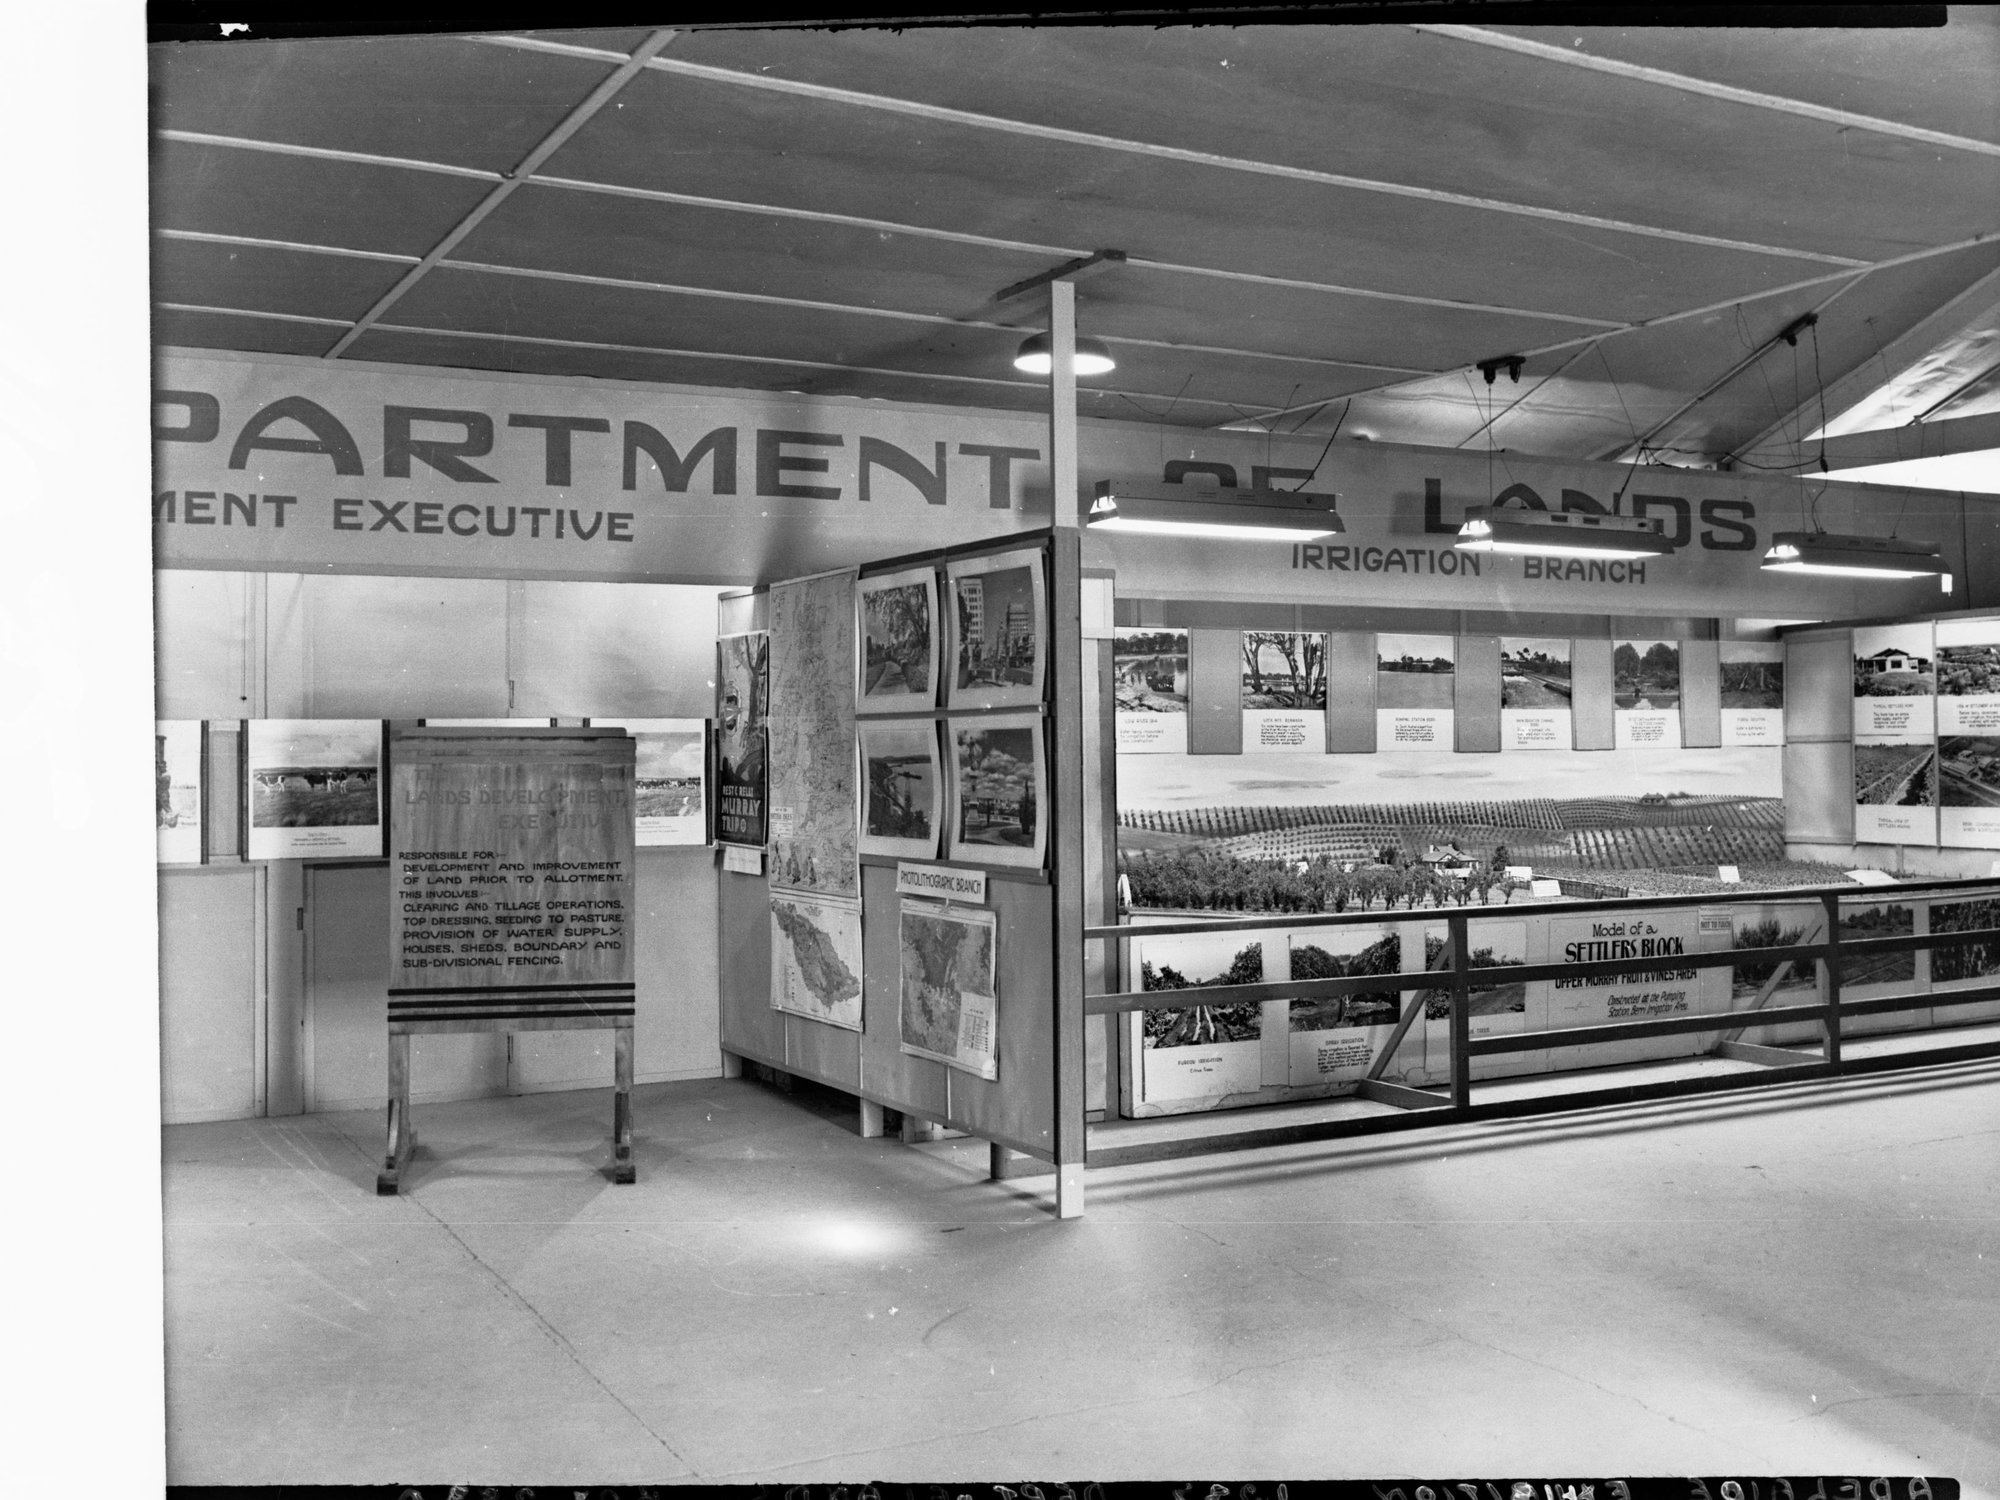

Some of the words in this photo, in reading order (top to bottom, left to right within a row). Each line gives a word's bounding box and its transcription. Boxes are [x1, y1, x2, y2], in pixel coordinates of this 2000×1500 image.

[152, 389, 1041, 509] PARTMENT
[333, 498, 634, 542] EXECUTIVE
[1293, 543, 1480, 578] IRRIGATION
[1524, 557, 1646, 584] BRANCH
[722, 784, 735, 797] REST
[721, 797, 761, 817] MURRAY
[499, 813, 608, 830] EXECUTIV
[721, 815, 740, 833] TRIP
[399, 851, 468, 860] RESPONSIBLE
[403, 863, 490, 873] DEVELOPMENT
[498, 862, 525, 871] AND
[533, 861, 621, 870] IMPROVEMENT
[403, 876, 419, 885] OF
[427, 875, 463, 884] LAND
[470, 874, 508, 884] PRIOR
[517, 875, 534, 884] TO
[543, 874, 624, 883] ALLOTMENT.
[901, 870, 955, 891] PHOTOLITHOGRAPHIC
[956, 878, 982, 894] BRANCH
[399, 890, 422, 899] THIS
[403, 903, 460, 913] CLEARING
[465, 902, 489, 912] AND
[495, 901, 541, 911] TILLAGE
[403, 917, 426, 926] TOP
[495, 915, 542, 924] SEEDING
[550, 914, 565, 923] TO
[403, 930, 475, 940] PROVISION
[482, 930, 500, 939] OF
[507, 928, 555, 938] WATER
[1592, 922, 1625, 937] Model
[1629, 921, 1643, 935] of
[1645, 924, 1658, 934] a
[514, 941, 587, 951] BOUNDARY
[594, 941, 622, 950] AND
[1565, 939, 1637, 963] SETTLERS
[1641, 936, 1684, 957] BLOCK
[403, 958, 502, 968] SUB-DIVISIONAL
[508, 956, 563, 966] FENCING.
[1585, 974, 1618, 987] MURRAY
[1607, 994, 1641, 1006] Constructed
[1660, 991, 1686, 1003] Pumping
